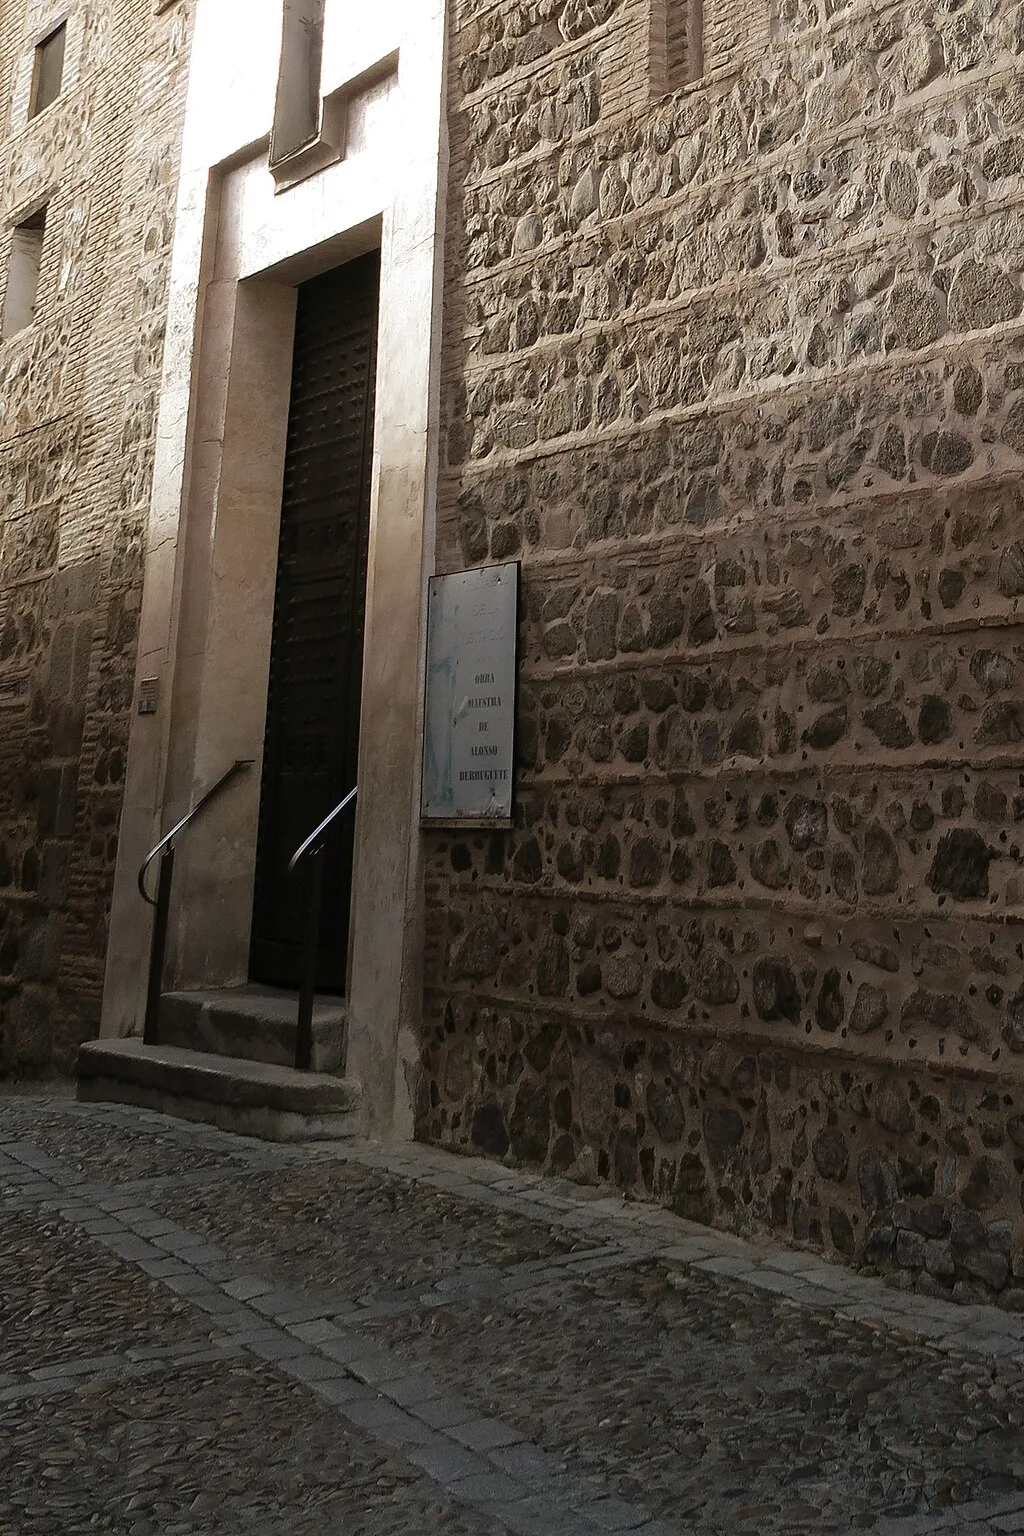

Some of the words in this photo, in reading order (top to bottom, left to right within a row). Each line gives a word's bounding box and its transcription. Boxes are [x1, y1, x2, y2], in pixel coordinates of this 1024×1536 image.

[474, 672, 494, 684] OBRA
[467, 696, 502, 709] MAESTRA
[478, 721, 489, 733] DE
[471, 745, 498, 757] ALONSO
